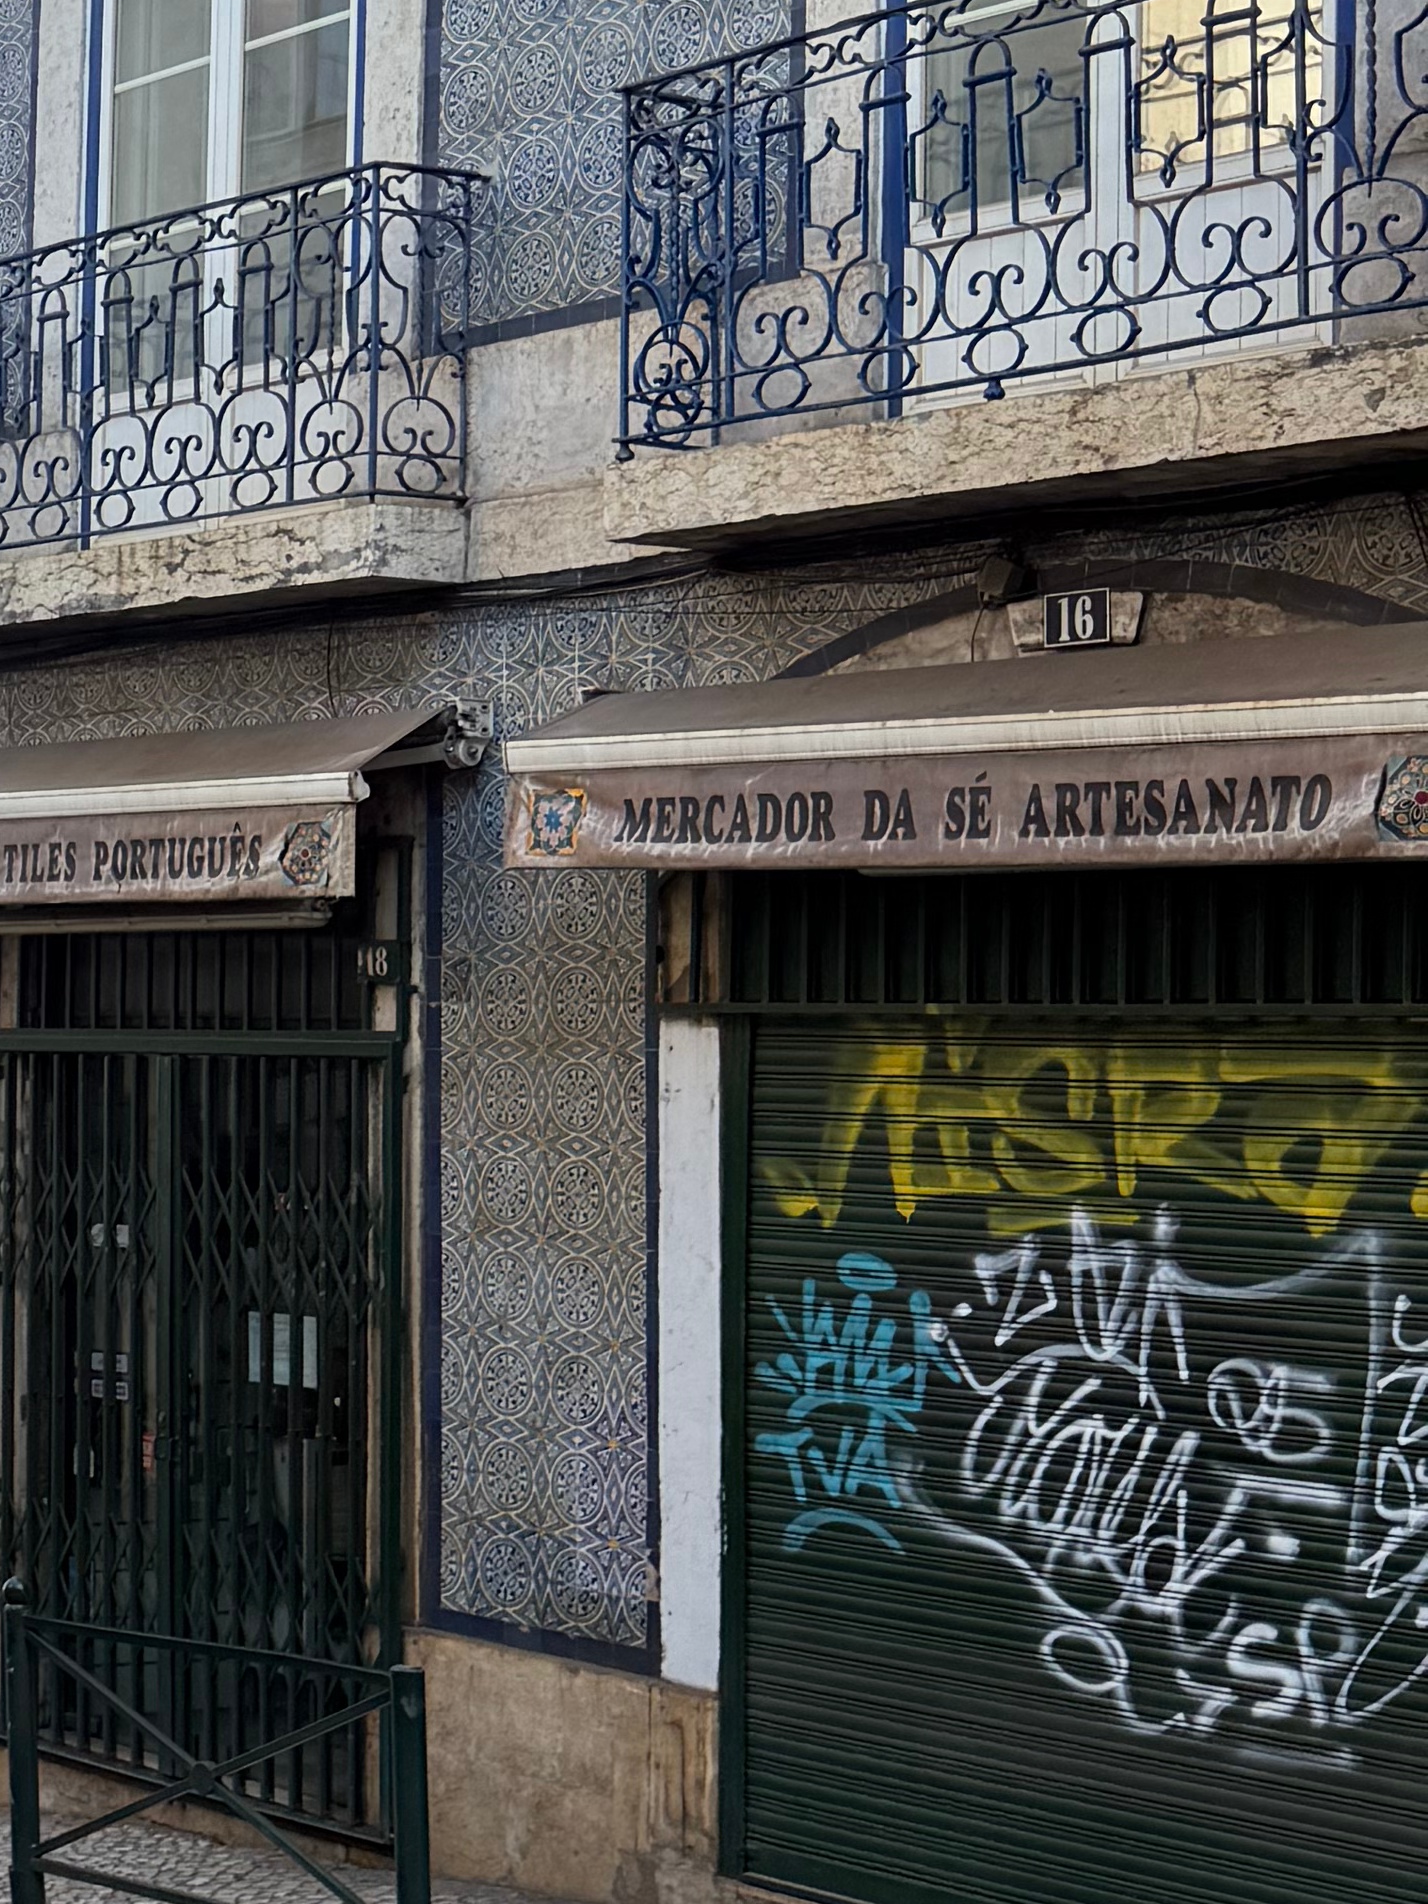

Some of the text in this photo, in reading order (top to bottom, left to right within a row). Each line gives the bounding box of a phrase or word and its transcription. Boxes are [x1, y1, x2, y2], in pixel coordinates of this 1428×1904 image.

[1057, 595, 1094, 642] 16
[613, 770, 1334, 845] MERCADOR DA SÉ ARTESANATO
[3, 841, 78, 884] TILES
[92, 821, 263, 882] PORTUGUÊS
[366, 946, 388, 976] 18
